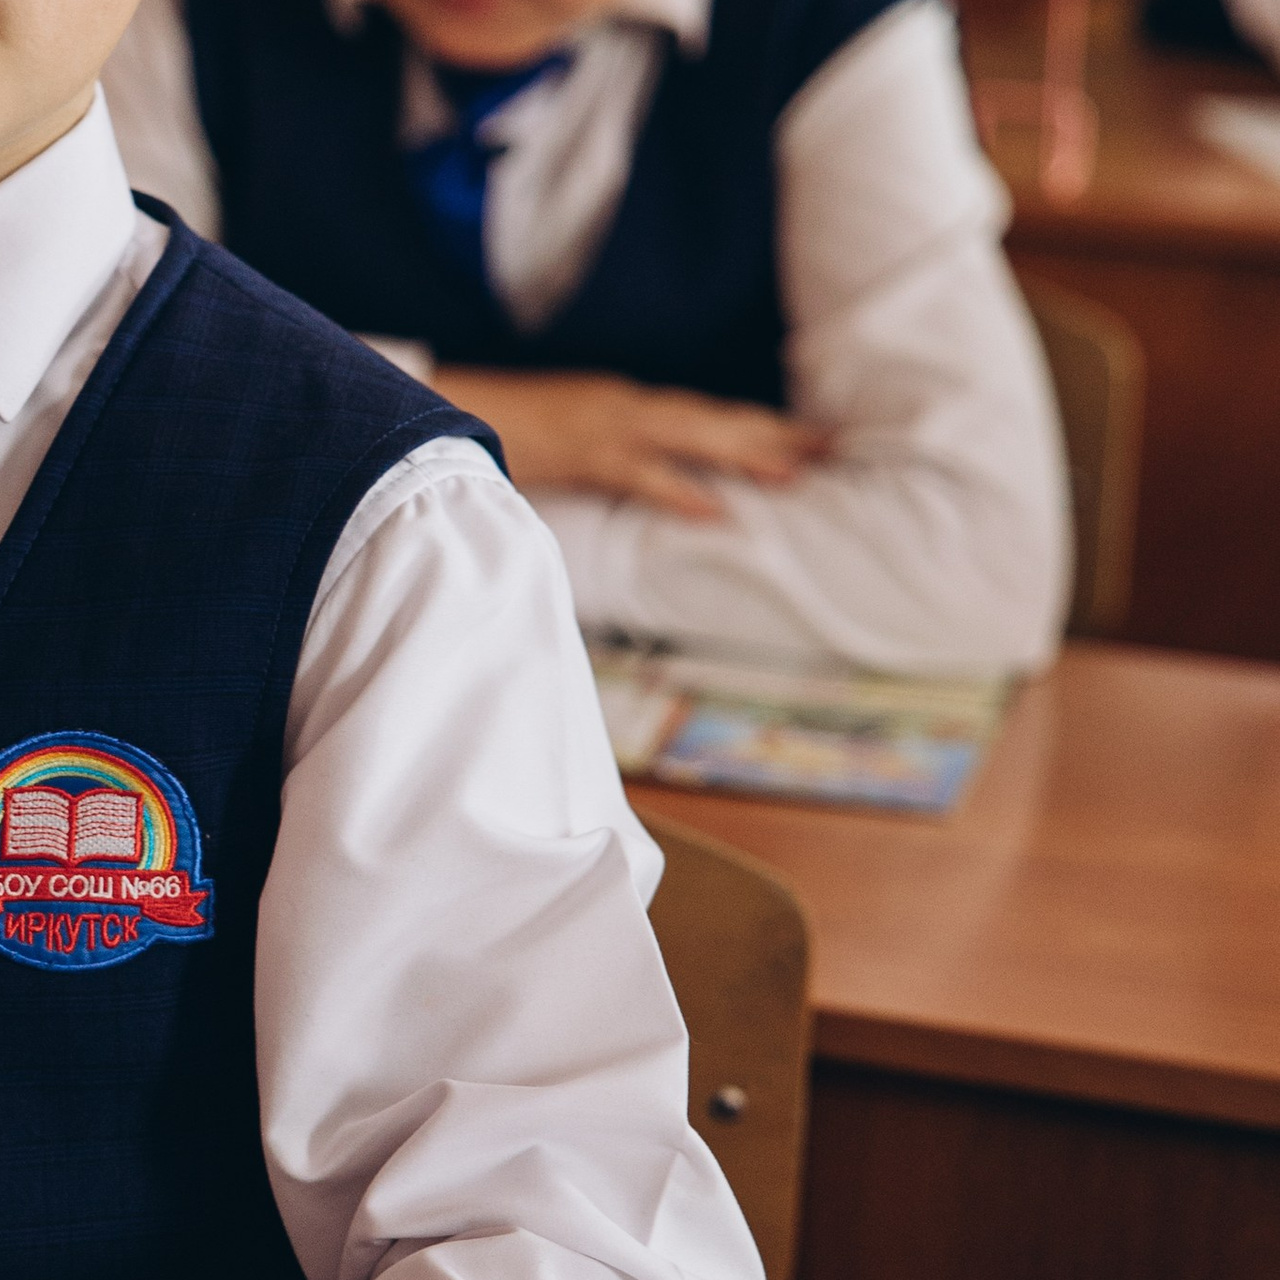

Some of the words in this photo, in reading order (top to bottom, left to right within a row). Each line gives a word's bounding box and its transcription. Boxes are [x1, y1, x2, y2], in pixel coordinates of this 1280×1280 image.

[48, 875, 114, 899] СОШ
[121, 876, 181, 900] №66
[4, 912, 142, 954] ИРКУТСК
